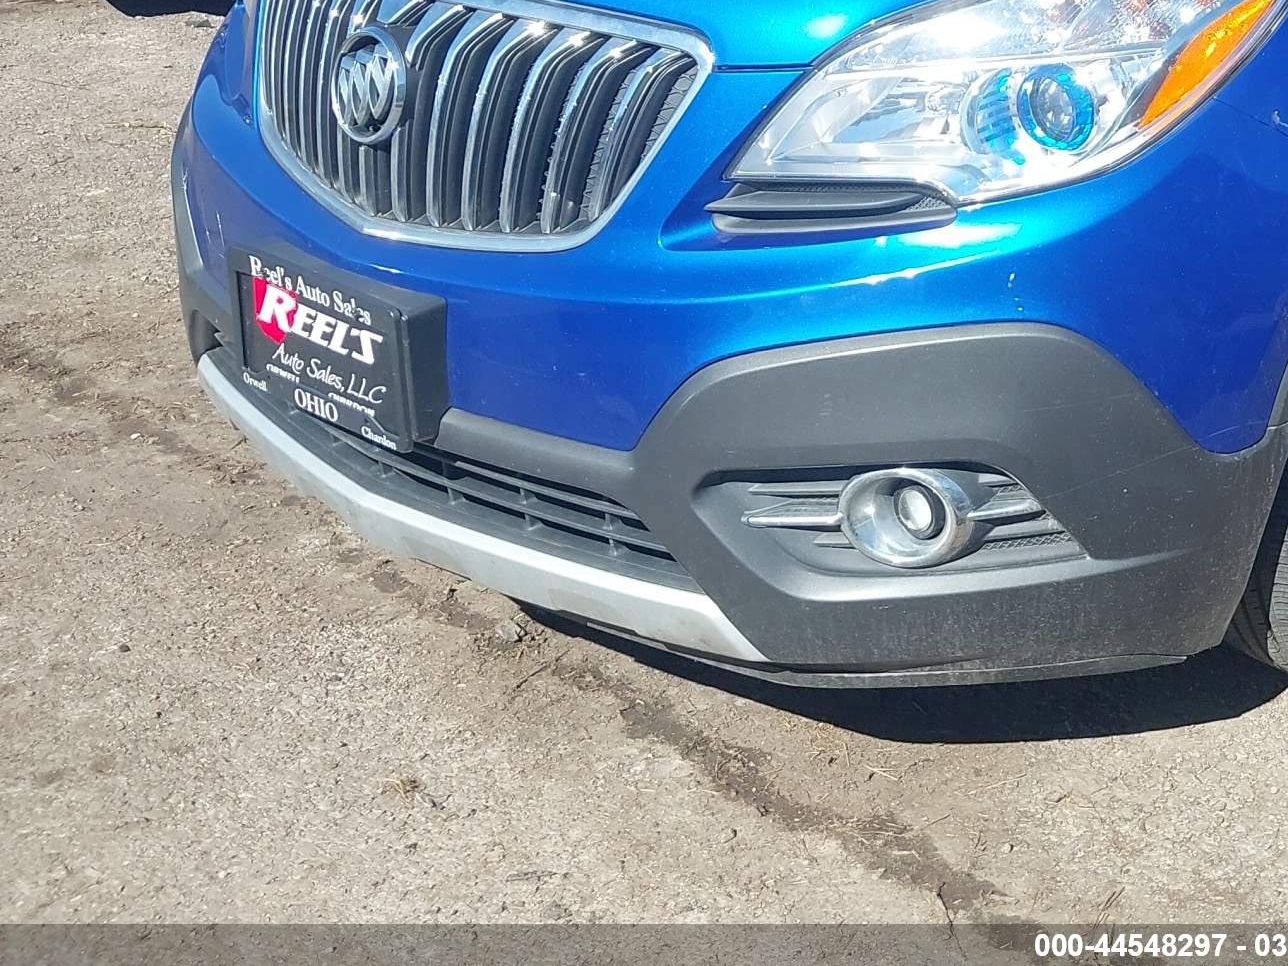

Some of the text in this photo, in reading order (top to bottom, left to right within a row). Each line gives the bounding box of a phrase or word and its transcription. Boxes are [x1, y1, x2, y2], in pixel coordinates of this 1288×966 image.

[295, 275, 331, 308] Auto
[256, 283, 383, 365] REEL'S
[272, 342, 387, 404] Auto Sales, LLC
[294, 388, 339, 422] OHIO
